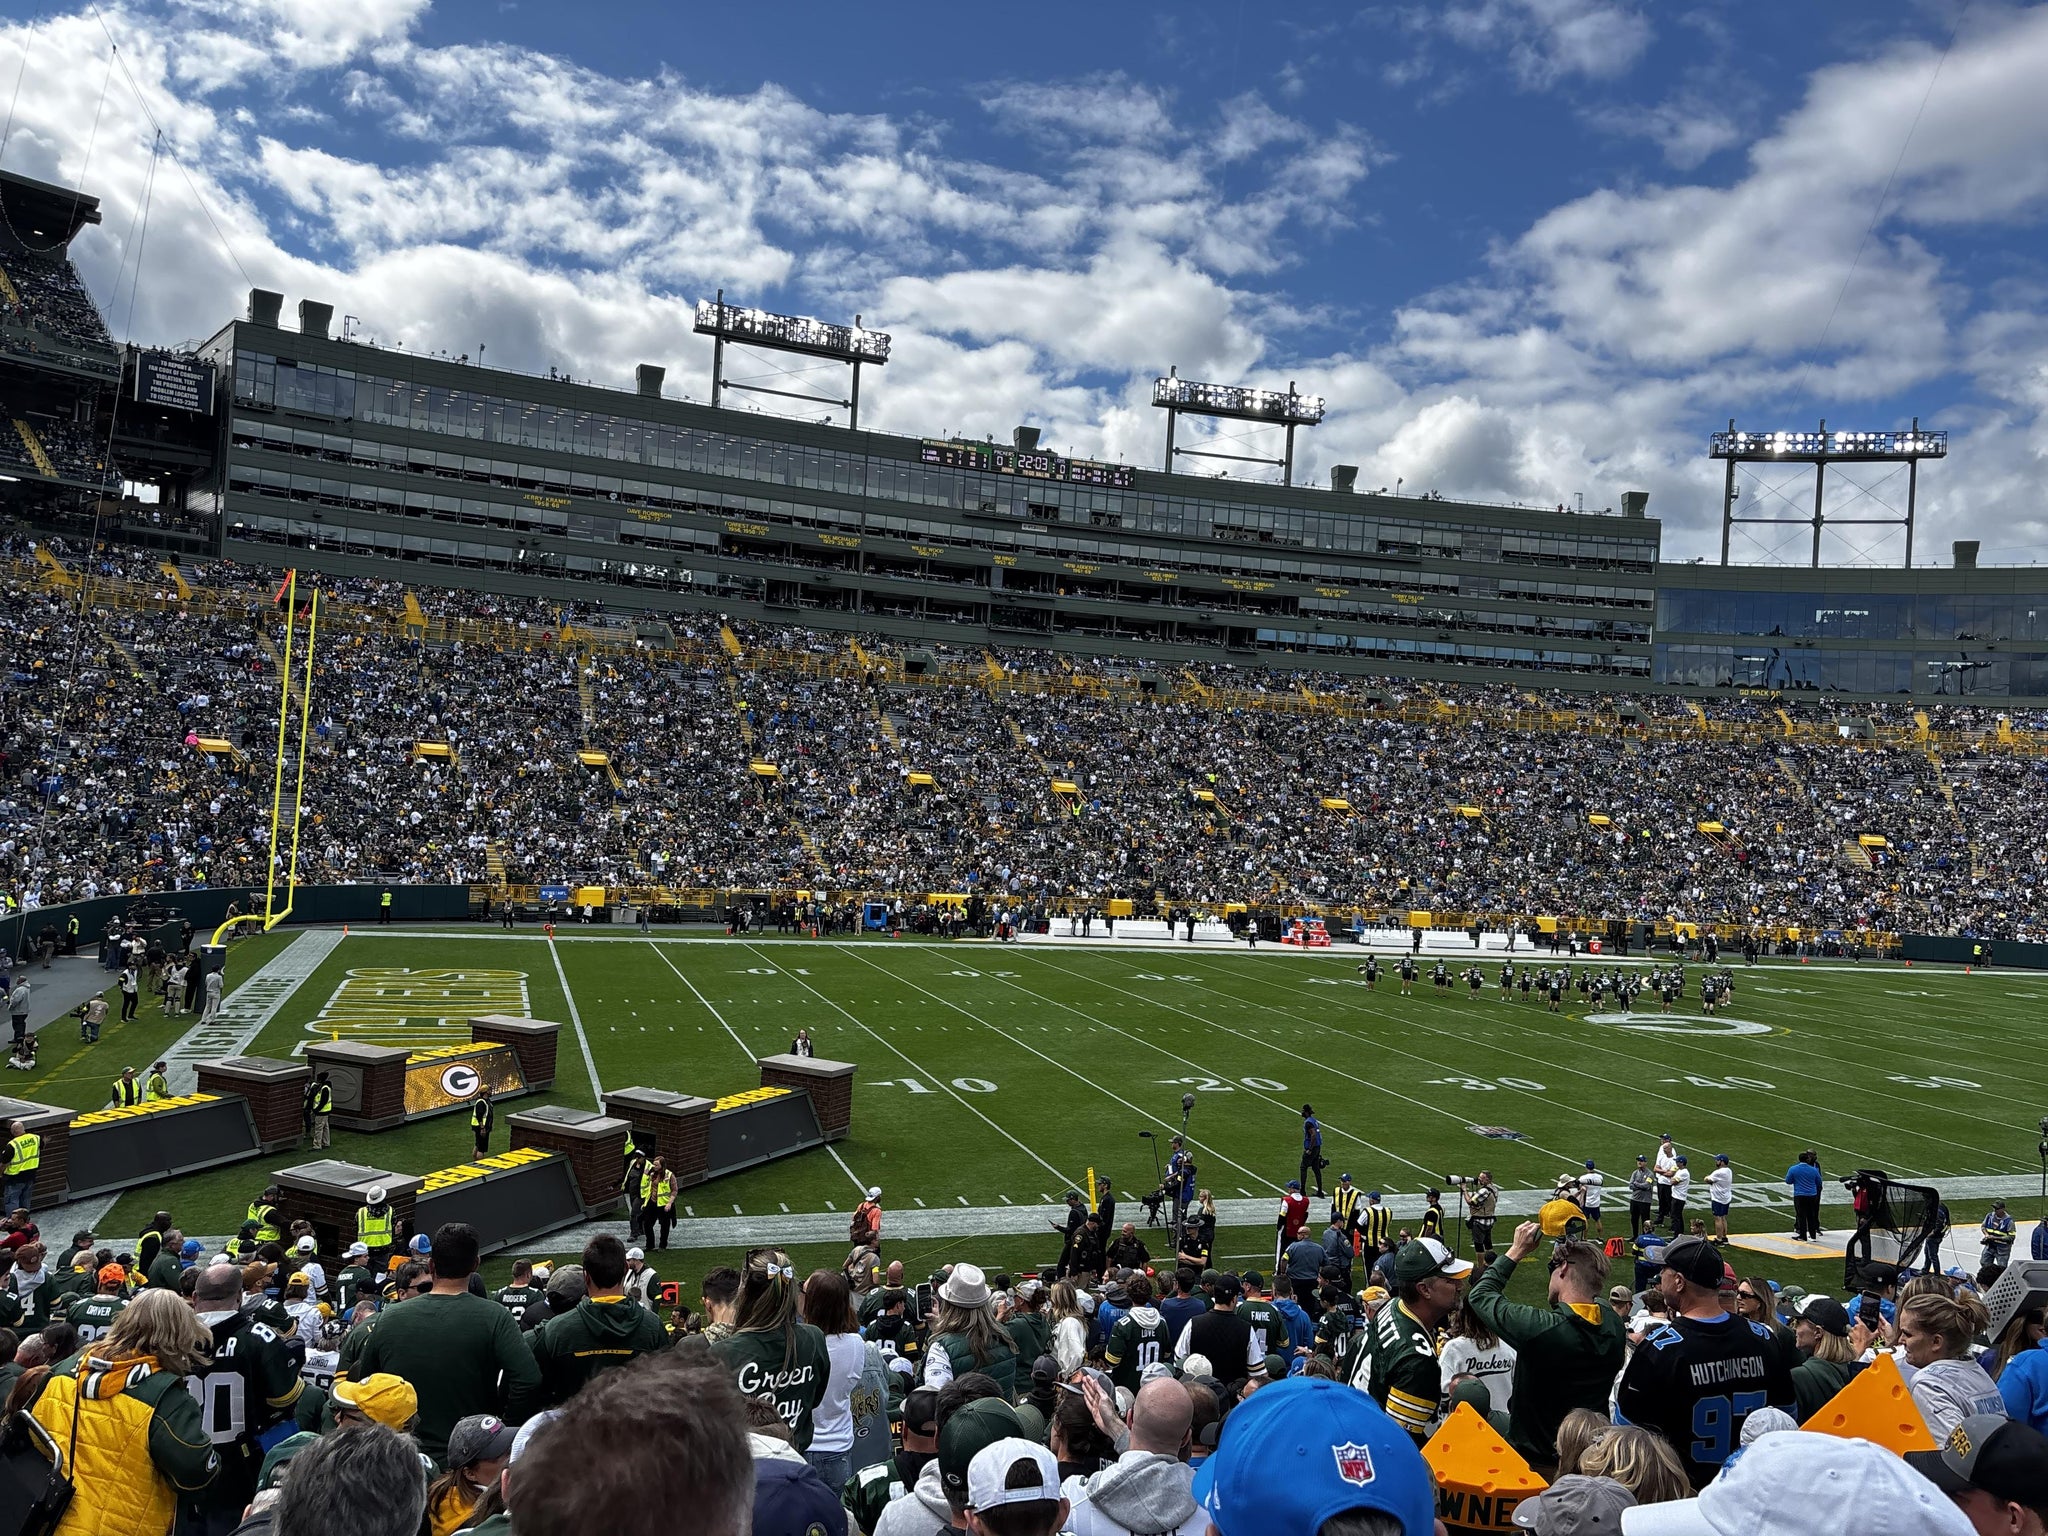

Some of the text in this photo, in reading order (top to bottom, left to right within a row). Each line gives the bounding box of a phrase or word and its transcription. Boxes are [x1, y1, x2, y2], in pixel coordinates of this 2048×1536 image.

[996, 456, 1003, 466] 0
[1018, 454, 1048, 471] 22:03
[1060, 464, 1066, 474] 0
[1751, 689, 1769, 697] PACK
[170, 977, 295, 1060] INSPIRE CHANGE
[441, 1063, 480, 1099] G
[895, 1078, 998, 1094] 10
[1180, 1076, 1289, 1092] 20
[1444, 1076, 1547, 1092] 30
[1679, 1075, 1777, 1090] 40
[1885, 1074, 1982, 1089] 50
[1611, 1240, 1624, 1258] 20
[20, 1291, 36, 1317] 4
[339, 1285, 347, 1310] 1
[502, 1294, 528, 1303] RODGERS
[86, 1304, 112, 1316] DRIVER
[1250, 1310, 1271, 1322] FAVRE
[1141, 1329, 1156, 1338] LOVE
[307, 1357, 329, 1368] ZOMBO
[1135, 1340, 1161, 1372] 10
[1466, 1354, 1512, 1372] Packers
[737, 1361, 816, 1394] Green
[1690, 1356, 1765, 1386] HUTCHINSON
[1341, 1461, 1371, 1479] NFL
